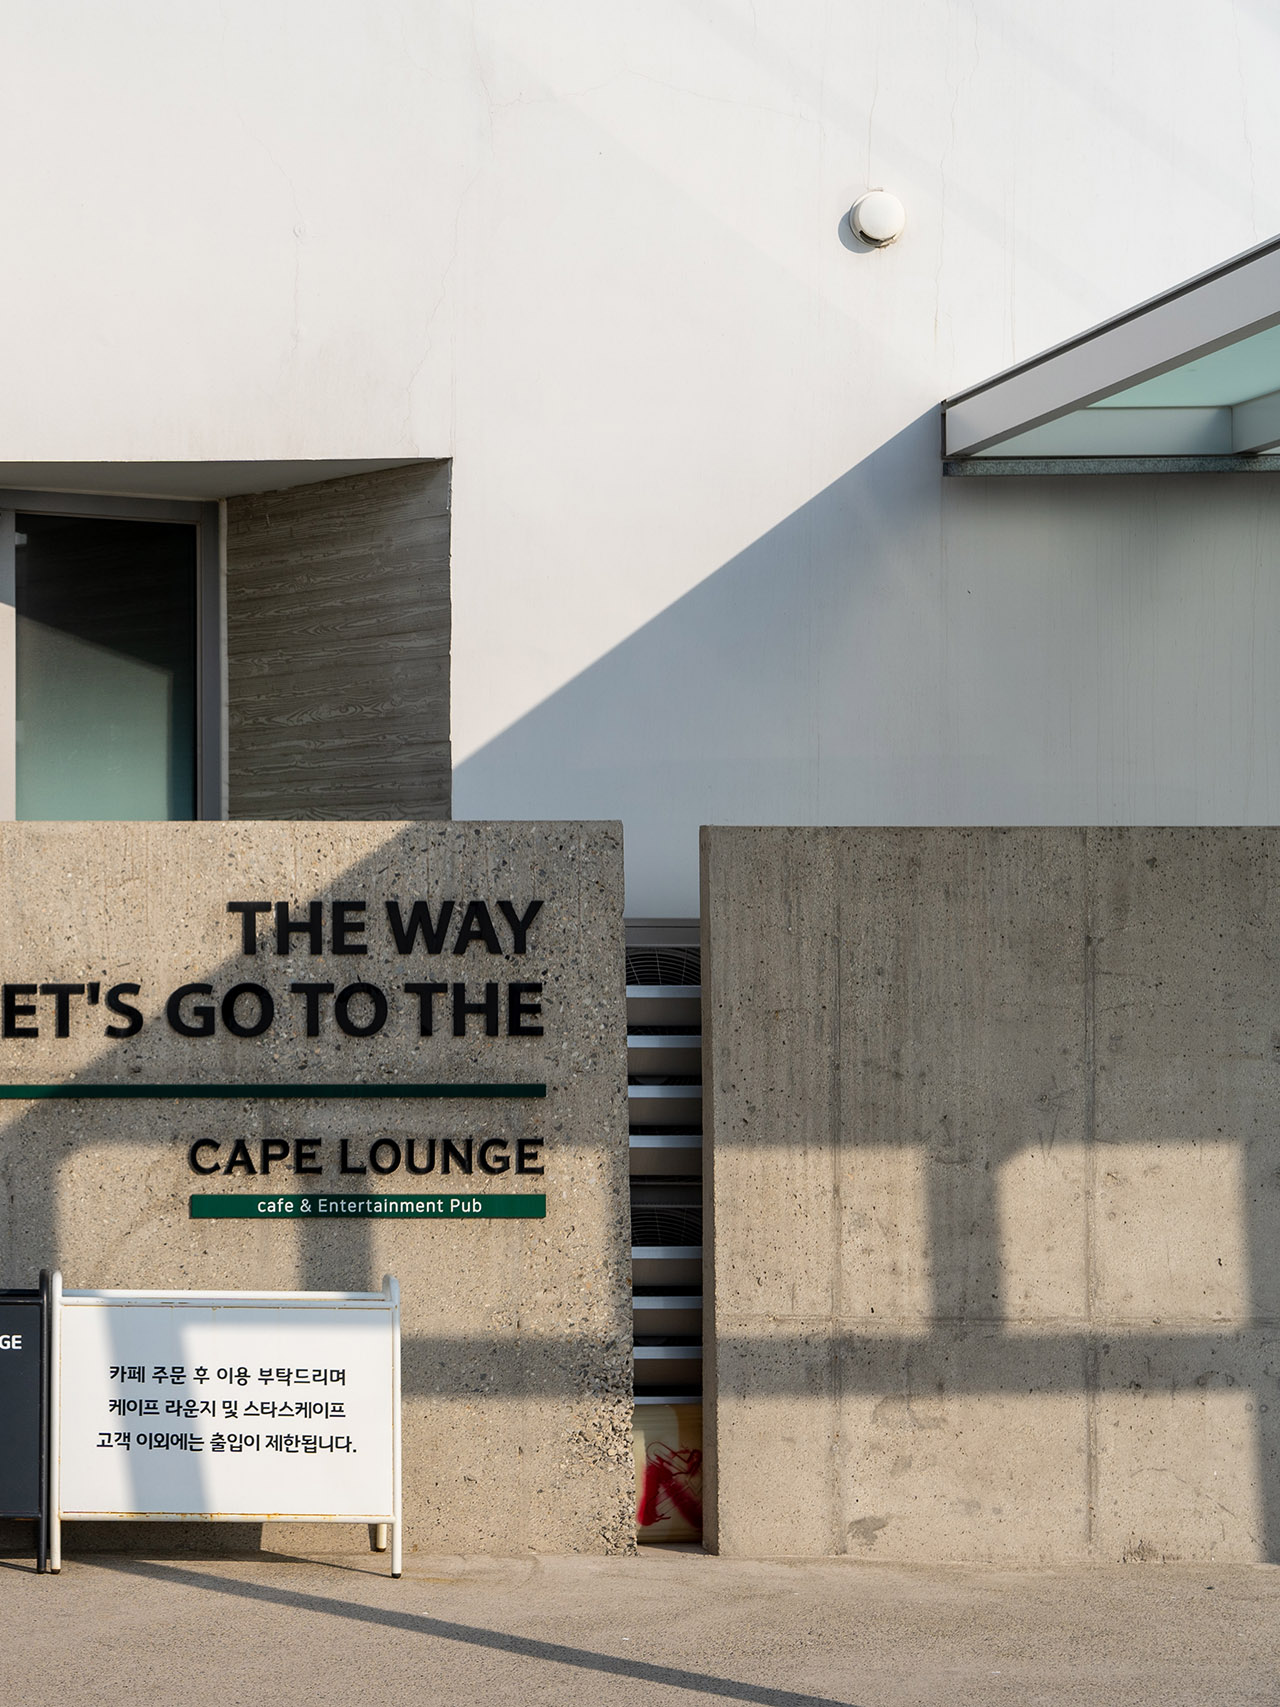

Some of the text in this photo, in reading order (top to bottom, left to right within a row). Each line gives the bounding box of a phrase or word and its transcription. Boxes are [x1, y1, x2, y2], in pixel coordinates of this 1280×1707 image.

[229, 901, 543, 955] THE WAY
[167, 983, 274, 1038] GO
[293, 982, 388, 1038] TO
[404, 982, 546, 1037] THE
[190, 1138, 544, 1175] CAPE LOUNGE
[258, 1198, 481, 1212] cafe & Entertainment Pub
[110, 1366, 345, 1386] 카페 주문 후 이용 부탁드리며
[109, 1399, 345, 1419] 케이프 라운지 및 스타스케이프
[97, 1432, 356, 1453] 고객 이외에는 출입이 제한됩니다.
